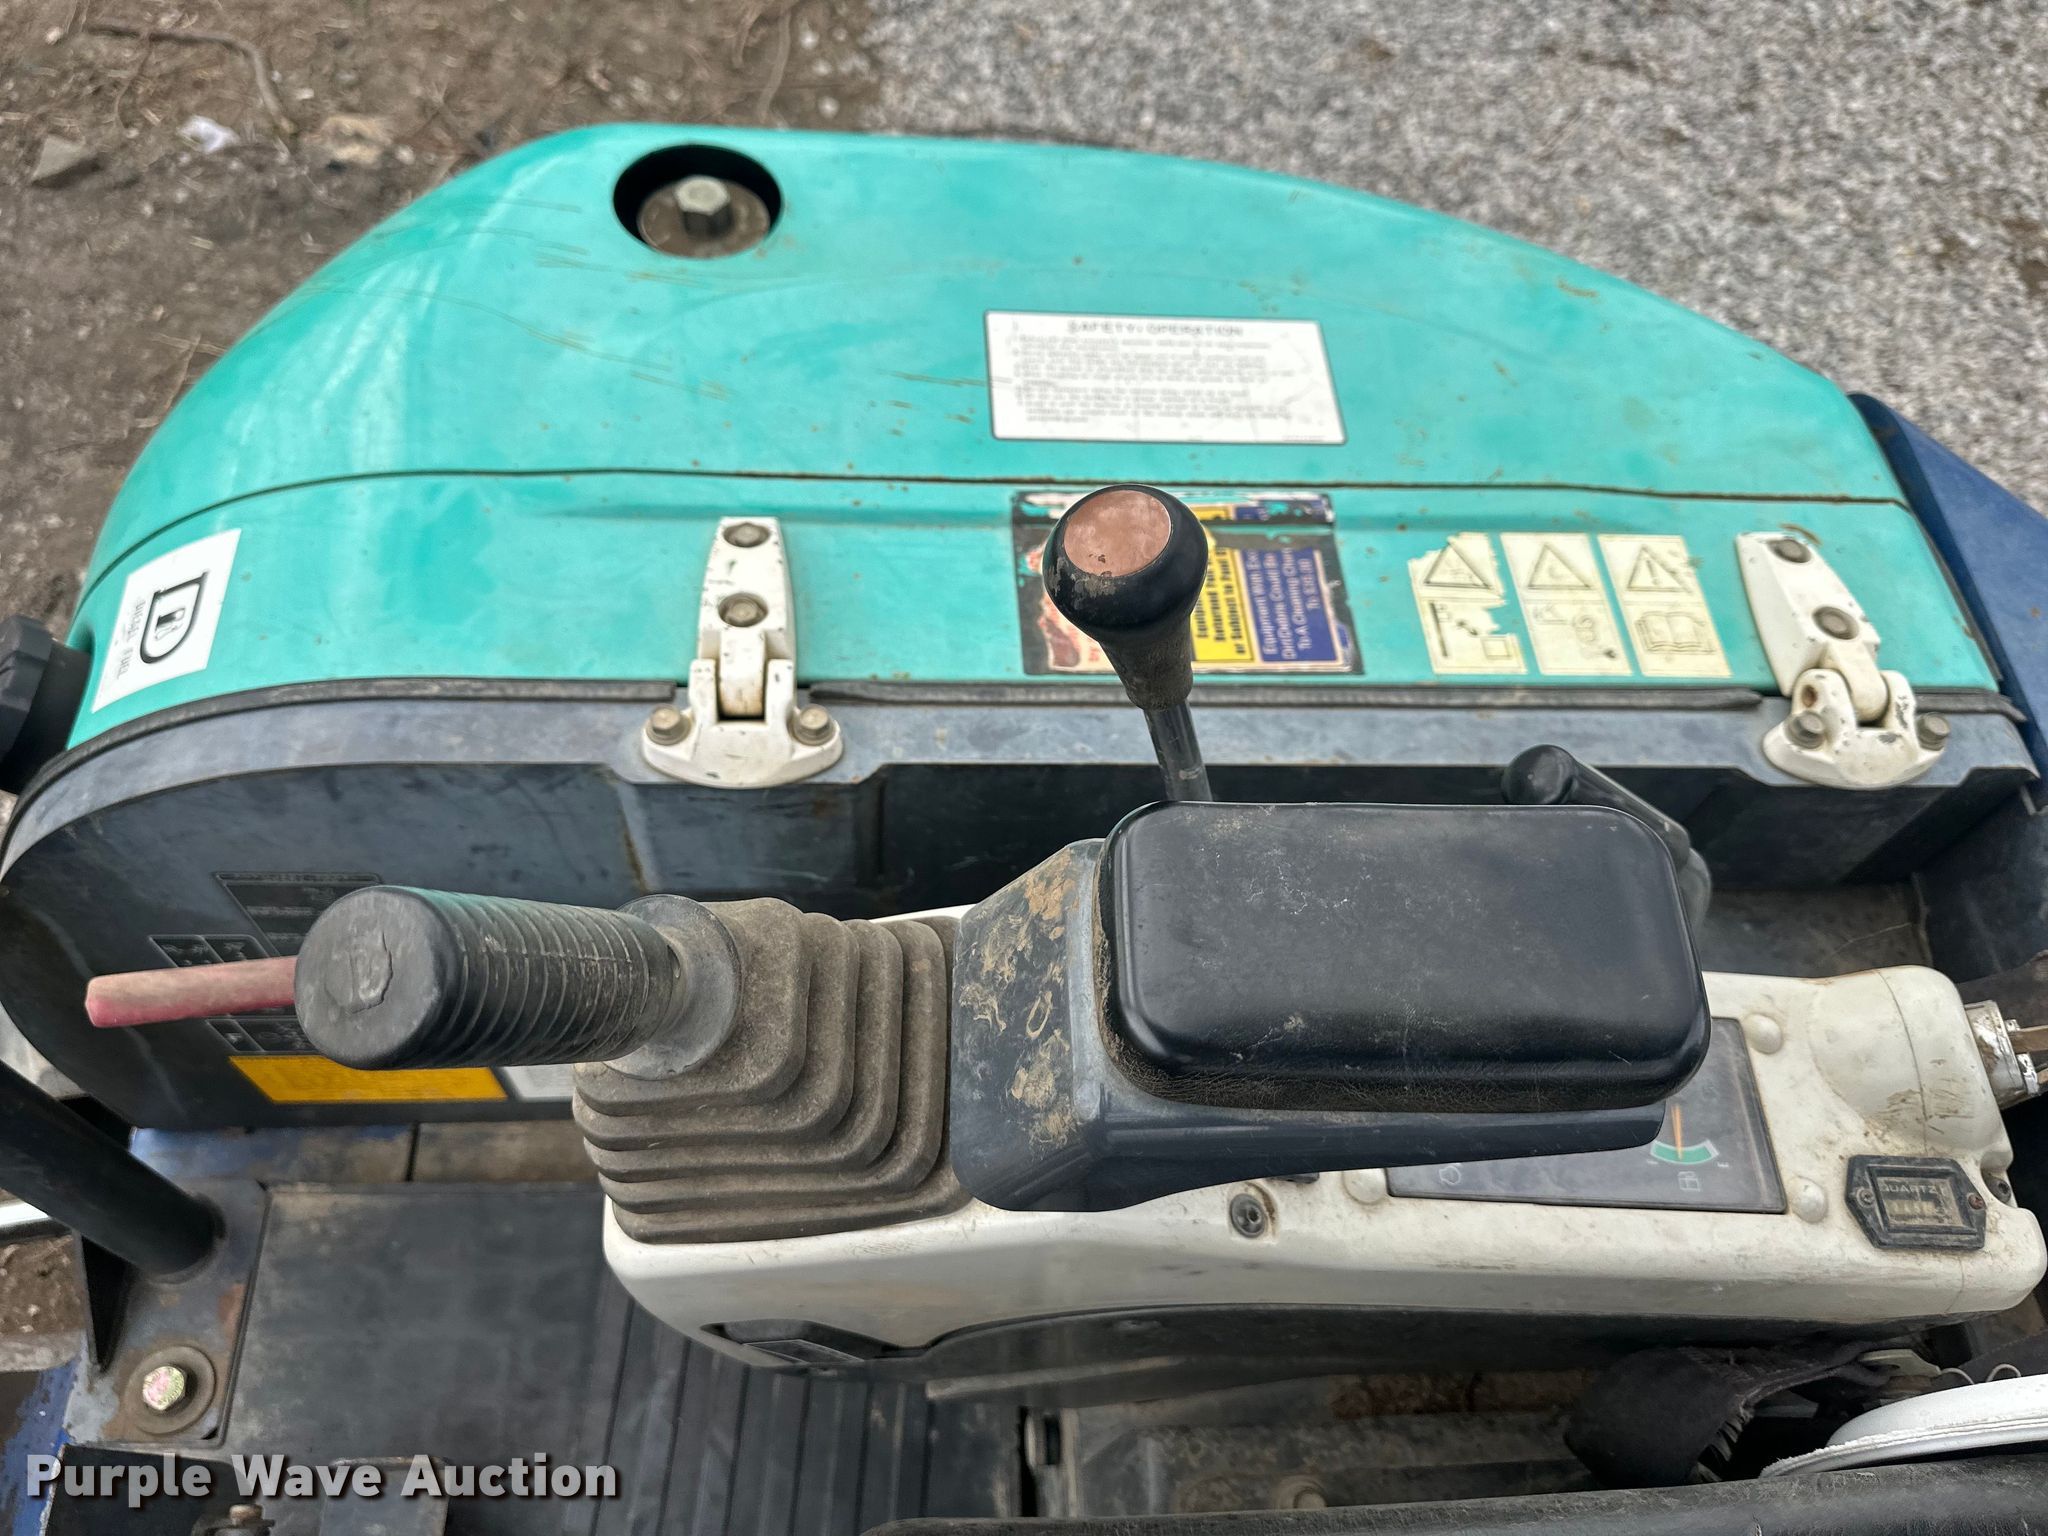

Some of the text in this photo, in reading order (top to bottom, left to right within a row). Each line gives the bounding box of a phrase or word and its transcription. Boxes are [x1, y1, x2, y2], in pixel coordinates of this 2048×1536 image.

[1254, 596, 1278, 655] Equipment
[1286, 576, 1307, 626] Cleaning
[1880, 1184, 1939, 1195] QUARTZ
